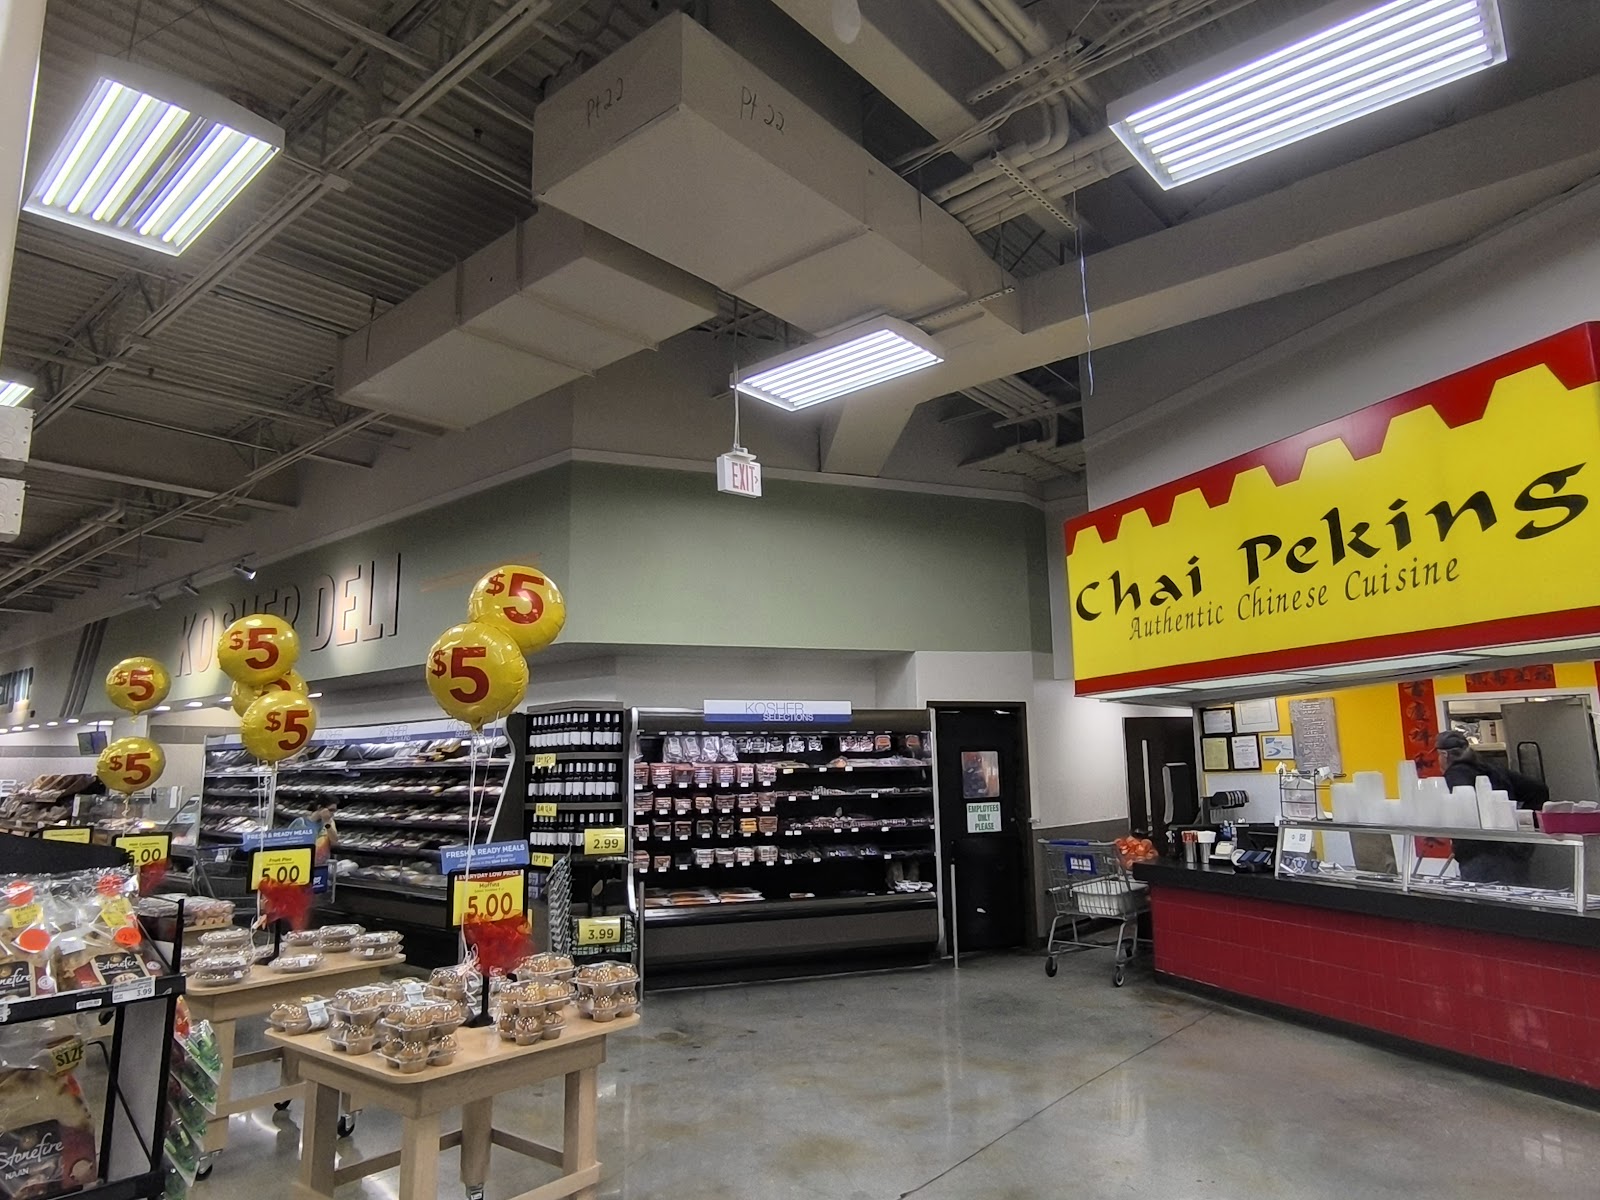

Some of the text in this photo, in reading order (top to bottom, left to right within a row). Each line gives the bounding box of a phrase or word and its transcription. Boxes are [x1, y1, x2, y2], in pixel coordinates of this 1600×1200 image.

[731, 461, 756, 493] EXIT
[486, 572, 545, 625] $5
[1075, 555, 1202, 622] Chai
[1129, 557, 1461, 641] Authentic Chinese Cuisine
[310, 552, 401, 652] DELI
[229, 628, 280, 670] $5
[114, 669, 155, 702] $5
[431, 646, 490, 704] $5
[745, 702, 805, 714] KOSHER
[762, 713, 815, 722] SELECTIONS
[265, 709, 310, 751] $5
[109, 752, 152, 785] $5
[968, 804, 999, 813] EMPLOYEES
[273, 830, 293, 838] READY
[974, 822, 995, 831] PLEASE
[478, 847, 501, 855] READY
[502, 843, 525, 852] MEALS
[593, 839, 619, 849] 2.99
[262, 865, 300, 883] 500
[468, 892, 513, 918] 5.00
[588, 928, 614, 940] 3.99
[5, 1167, 29, 1180] NAAN
